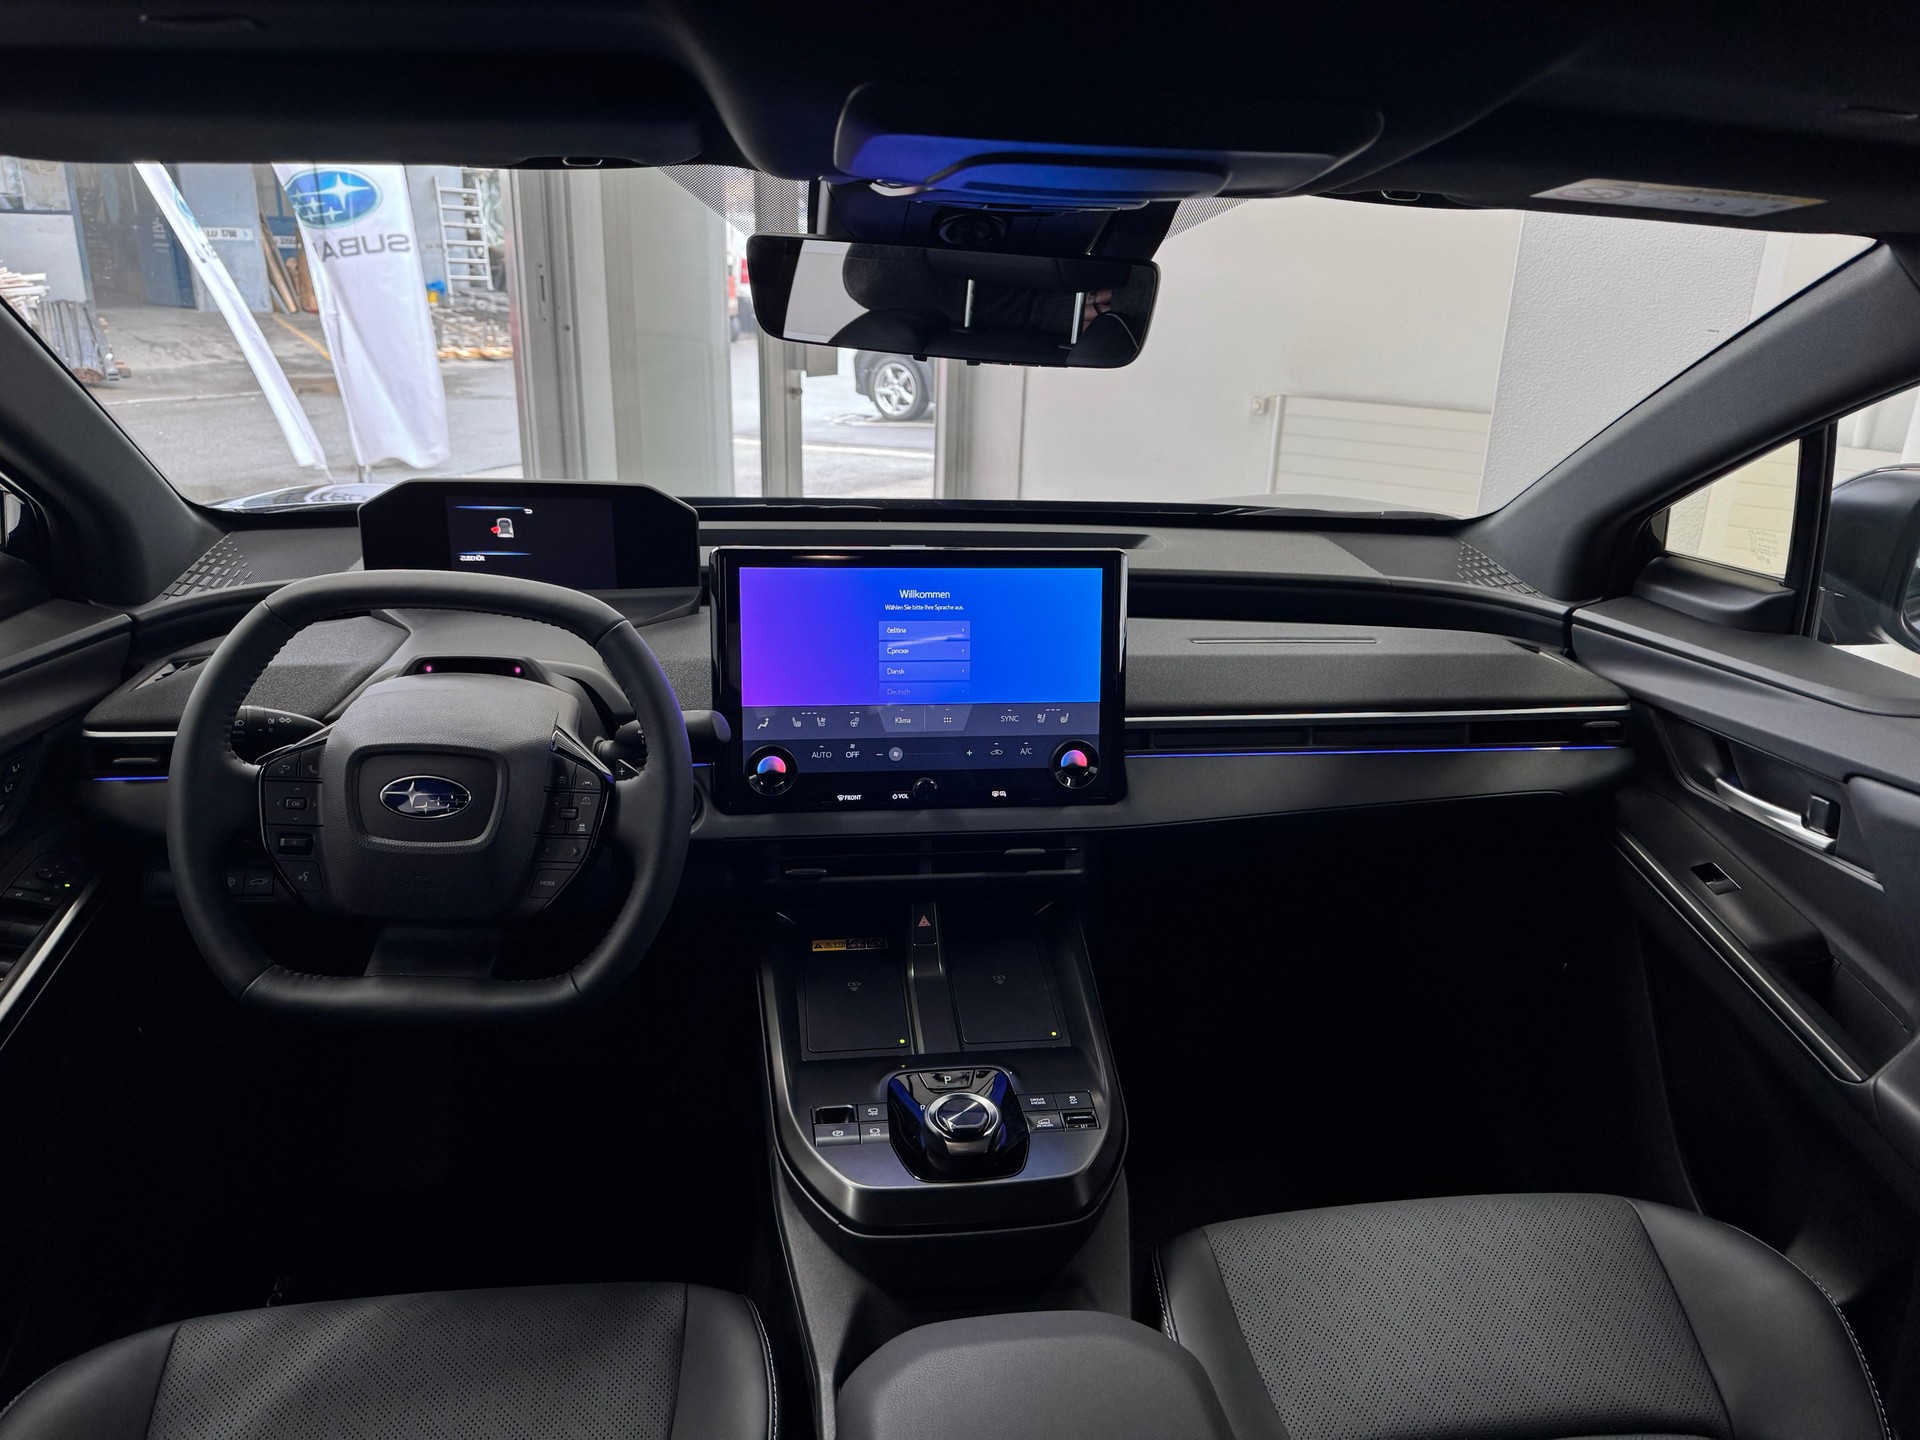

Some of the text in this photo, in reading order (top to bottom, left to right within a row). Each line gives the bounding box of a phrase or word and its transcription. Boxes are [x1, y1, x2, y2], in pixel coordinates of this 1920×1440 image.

[899, 589, 951, 599] Willkommen
[934, 604, 954, 612] Sprache
[886, 667, 905, 675] Dansk
[886, 688, 911, 696] Deutsch
[894, 716, 912, 724] Klima
[1000, 715, 1020, 723] SYNC
[811, 751, 833, 759] AUTO
[845, 751, 860, 759] OFF
[1019, 747, 1033, 756] A/C
[943, 1075, 952, 1085] P
